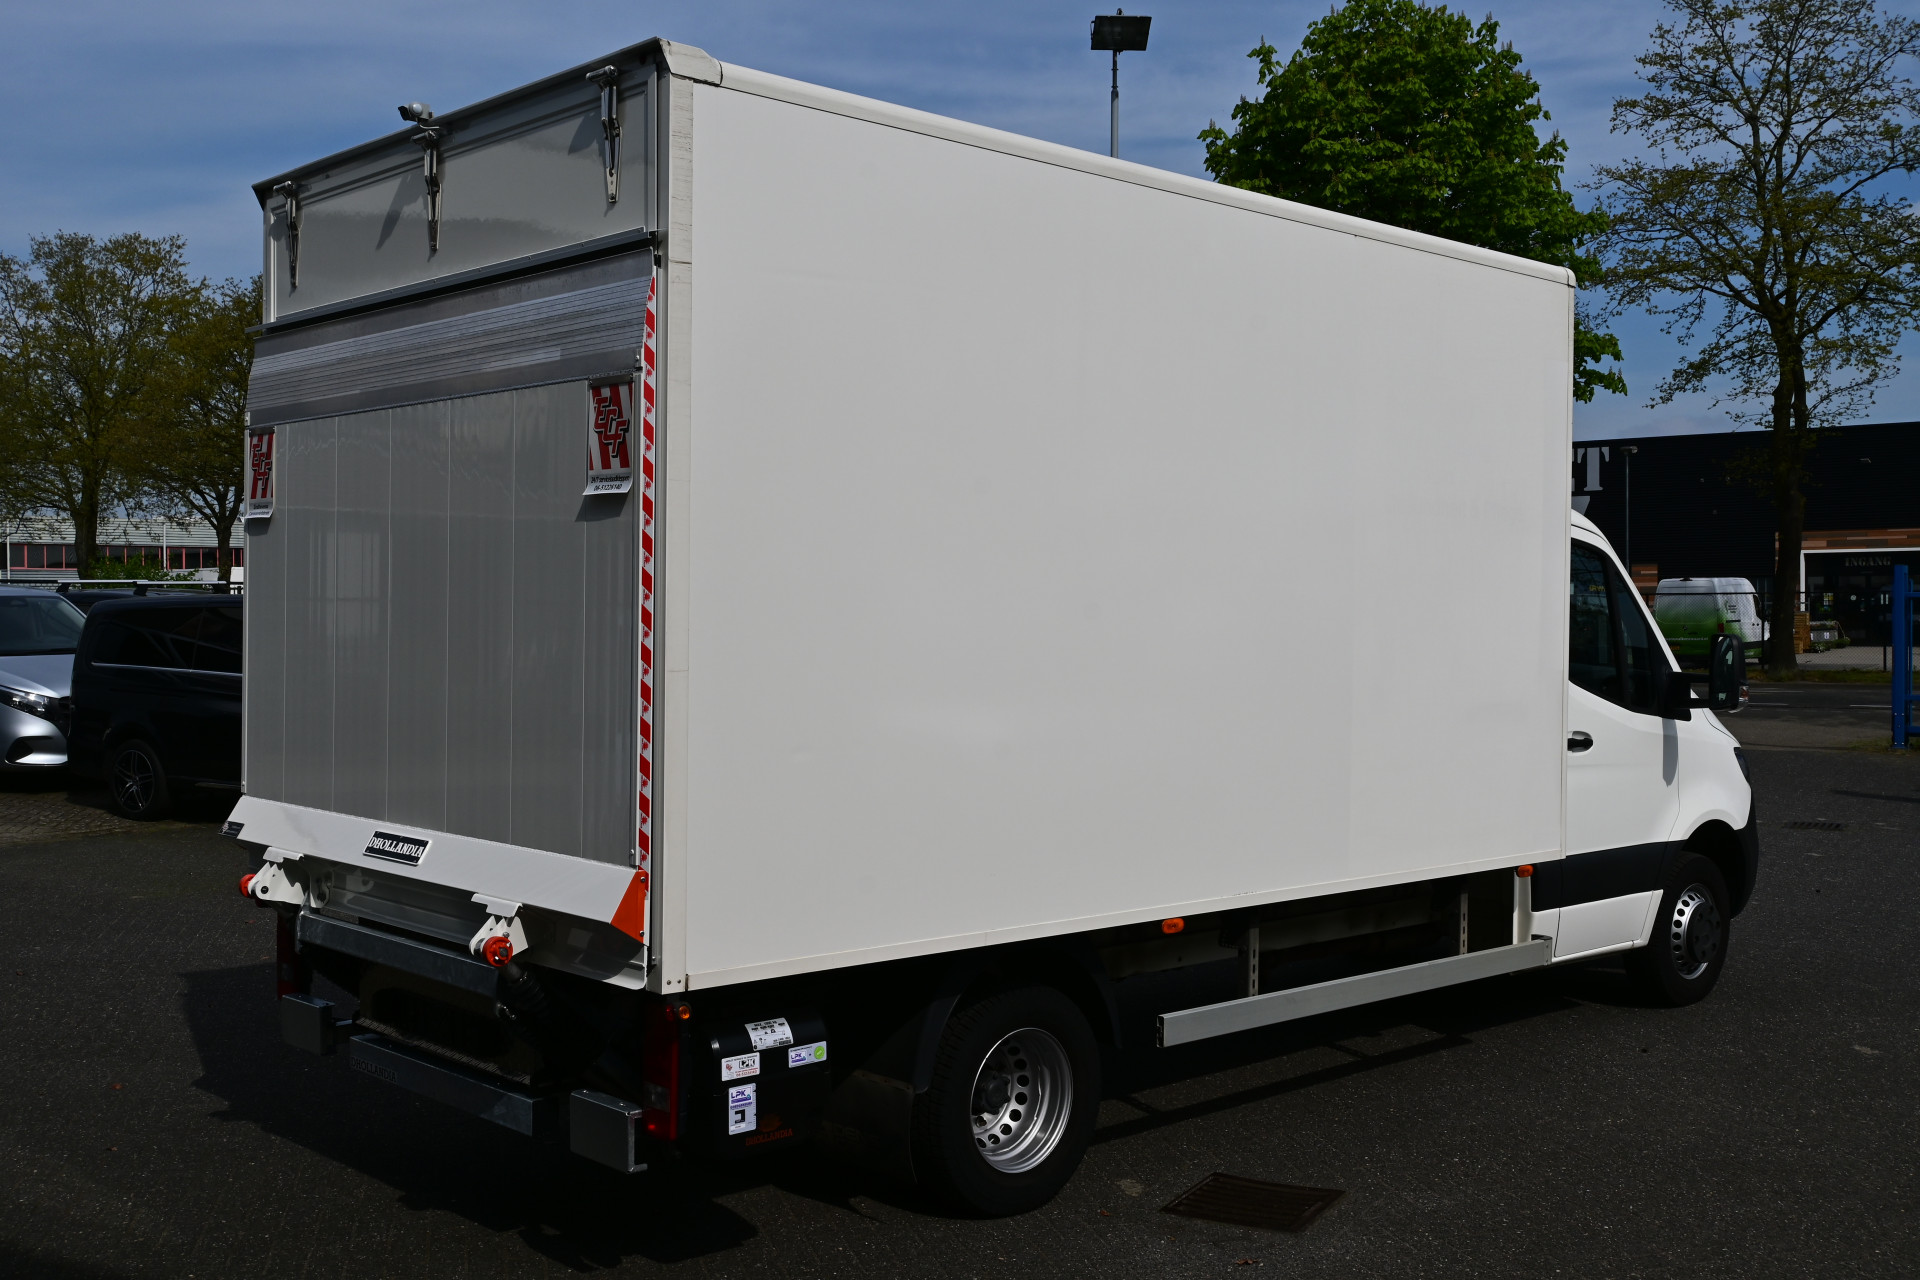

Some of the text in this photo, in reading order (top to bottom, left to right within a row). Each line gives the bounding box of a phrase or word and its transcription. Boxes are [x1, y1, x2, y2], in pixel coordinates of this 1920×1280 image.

[1572, 446, 1610, 491] T
[1845, 556, 1892, 567] INGANG
[368, 837, 425, 857] DHOLLANDIA
[352, 1056, 397, 1083] DHOLLANDIA
[731, 1090, 746, 1099] LPK
